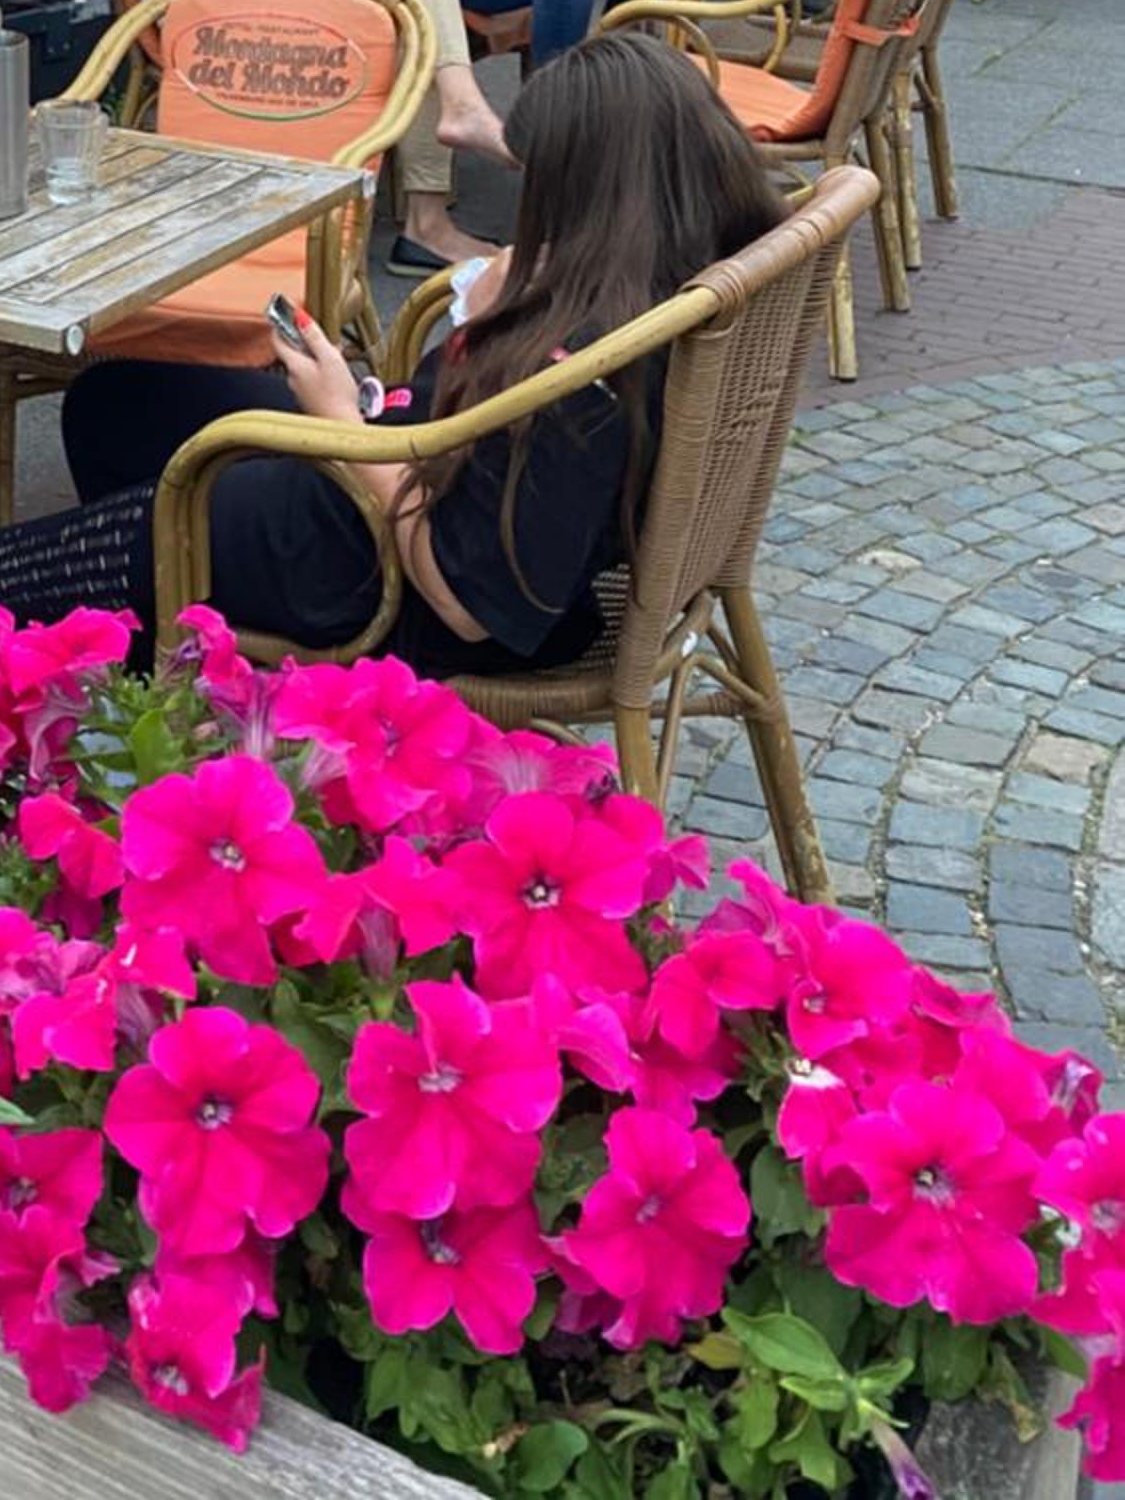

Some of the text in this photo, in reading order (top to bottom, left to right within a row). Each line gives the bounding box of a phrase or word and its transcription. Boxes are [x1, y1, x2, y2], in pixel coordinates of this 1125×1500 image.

[193, 26, 348, 73] Montagna
[188, 58, 349, 99] del Mondo
